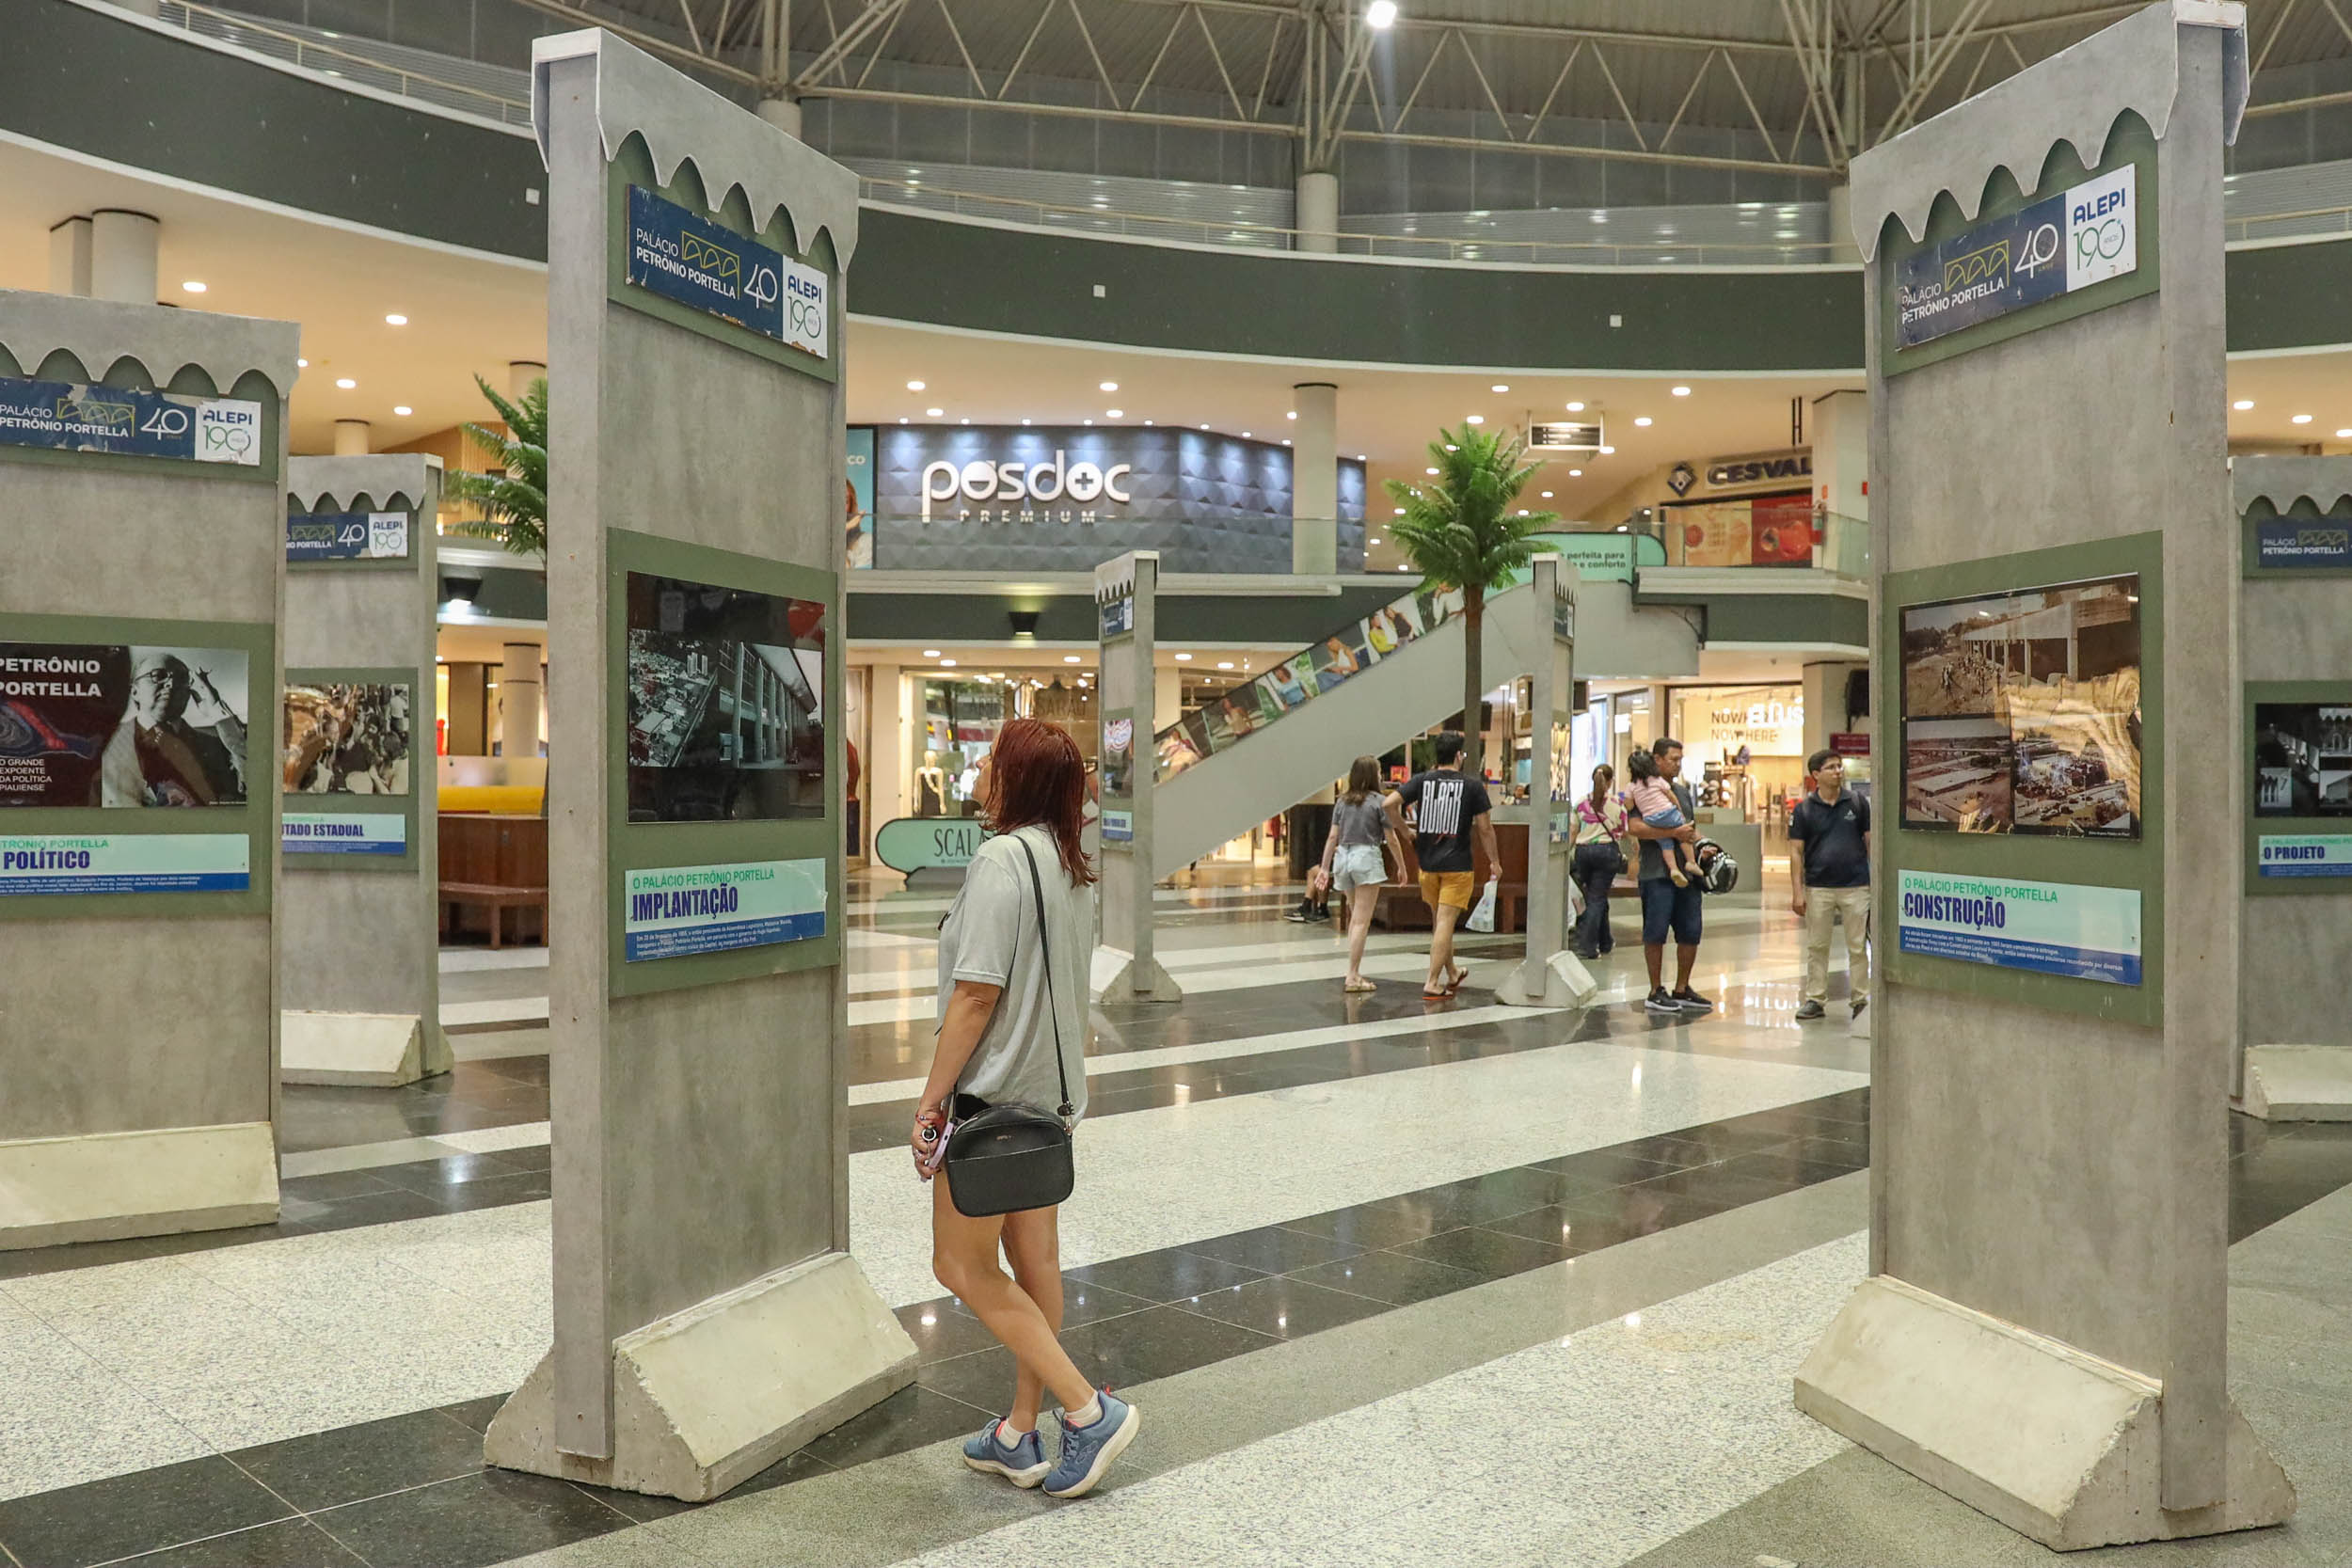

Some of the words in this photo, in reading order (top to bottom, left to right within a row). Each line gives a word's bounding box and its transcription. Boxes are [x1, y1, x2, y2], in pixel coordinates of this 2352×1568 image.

[2073, 188, 2126, 226] ALEPI
[636, 228, 679, 258] PALÁCIO
[2013, 223, 2058, 279] 40
[2073, 218, 2125, 271] 190
[636, 246, 687, 278] PETRÔNIO
[688, 267, 737, 300] PORTELLA
[743, 263, 778, 309] 40
[787, 275, 821, 304] ALEPI
[1901, 282, 1943, 306] PALÁCIO
[1901, 295, 1950, 325] PETRÔNIO
[1951, 277, 2005, 308] PORTELLA
[787, 295, 821, 340] 190
[0, 417, 62, 432] PETRÔNIO
[65, 423, 129, 438] PORTELLA
[140, 407, 189, 440] 40
[202, 409, 253, 425] ALEPI
[203, 424, 251, 451] 190
[373, 521, 405, 531] ALEPI
[960, 510, 1095, 523] PREMIUM
[296, 540, 332, 548] PORTELLA
[337, 524, 365, 547] 40
[1566, 551, 1602, 561] perfeita
[1604, 552, 1625, 561] para
[2263, 546, 2302, 555] PETRÔNIO
[2303, 546, 2344, 554] PORTELLA
[313, 824, 364, 837] ESTADUAL
[49, 839, 109, 848] PORTELLA
[2264, 847, 2271, 860] O
[2275, 847, 2325, 860] PROJETO
[3, 847, 90, 869] POLÍTICO
[633, 877, 641, 890] O
[643, 874, 684, 888] PALÁCIO
[686, 870, 731, 886] PETRÔNIO
[733, 868, 775, 881] PORTELLA
[1904, 878, 1911, 889] O
[1913, 878, 1951, 893] PALÁCIO
[1953, 881, 2002, 897] PETRÔNIO
[2004, 886, 2058, 903] PORTELLA
[632, 882, 739, 922] IMPLANTAÇÃO
[1904, 892, 2006, 930] CONSTRUÇÃO
